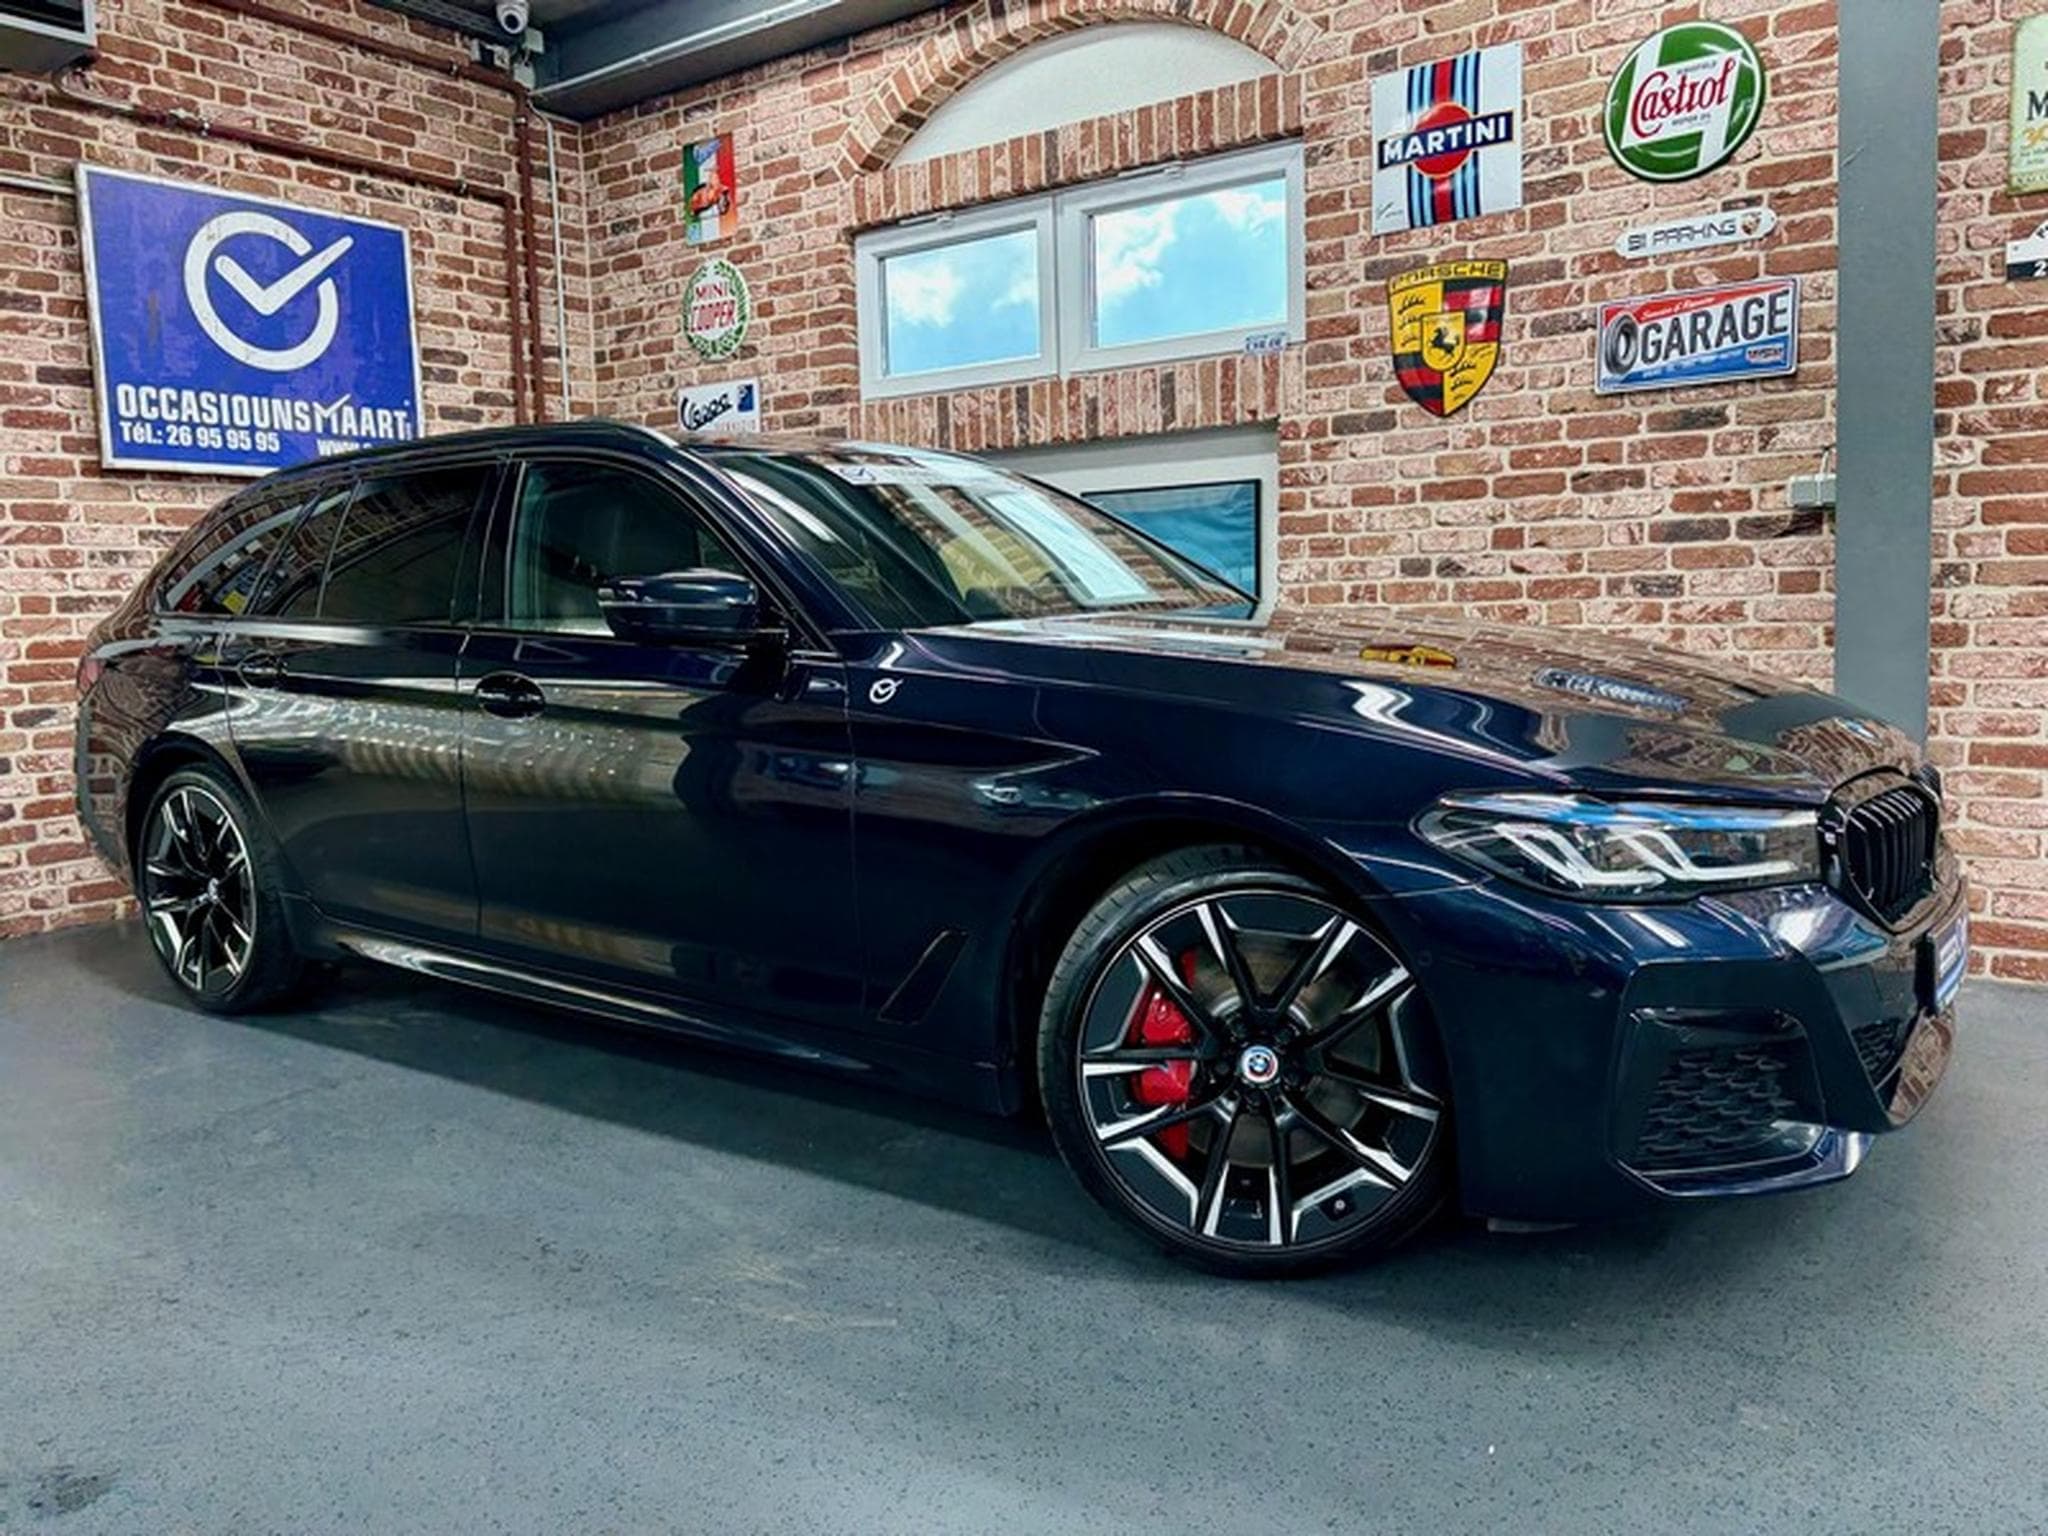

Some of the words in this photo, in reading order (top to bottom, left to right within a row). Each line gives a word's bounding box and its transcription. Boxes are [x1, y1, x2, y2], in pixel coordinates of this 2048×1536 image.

[1631, 57, 1736, 138] Castrol
[1384, 116, 1506, 164] MARTINI
[1652, 218, 1736, 247] PARKING
[1391, 261, 1502, 290] PORSCHE
[1640, 289, 1790, 365] GARAGE
[115, 382, 408, 441] OCCASIOUNSMAART
[166, 424, 192, 447] 26
[195, 426, 222, 449] 95
[225, 428, 252, 451] 95
[254, 431, 281, 453] 95
